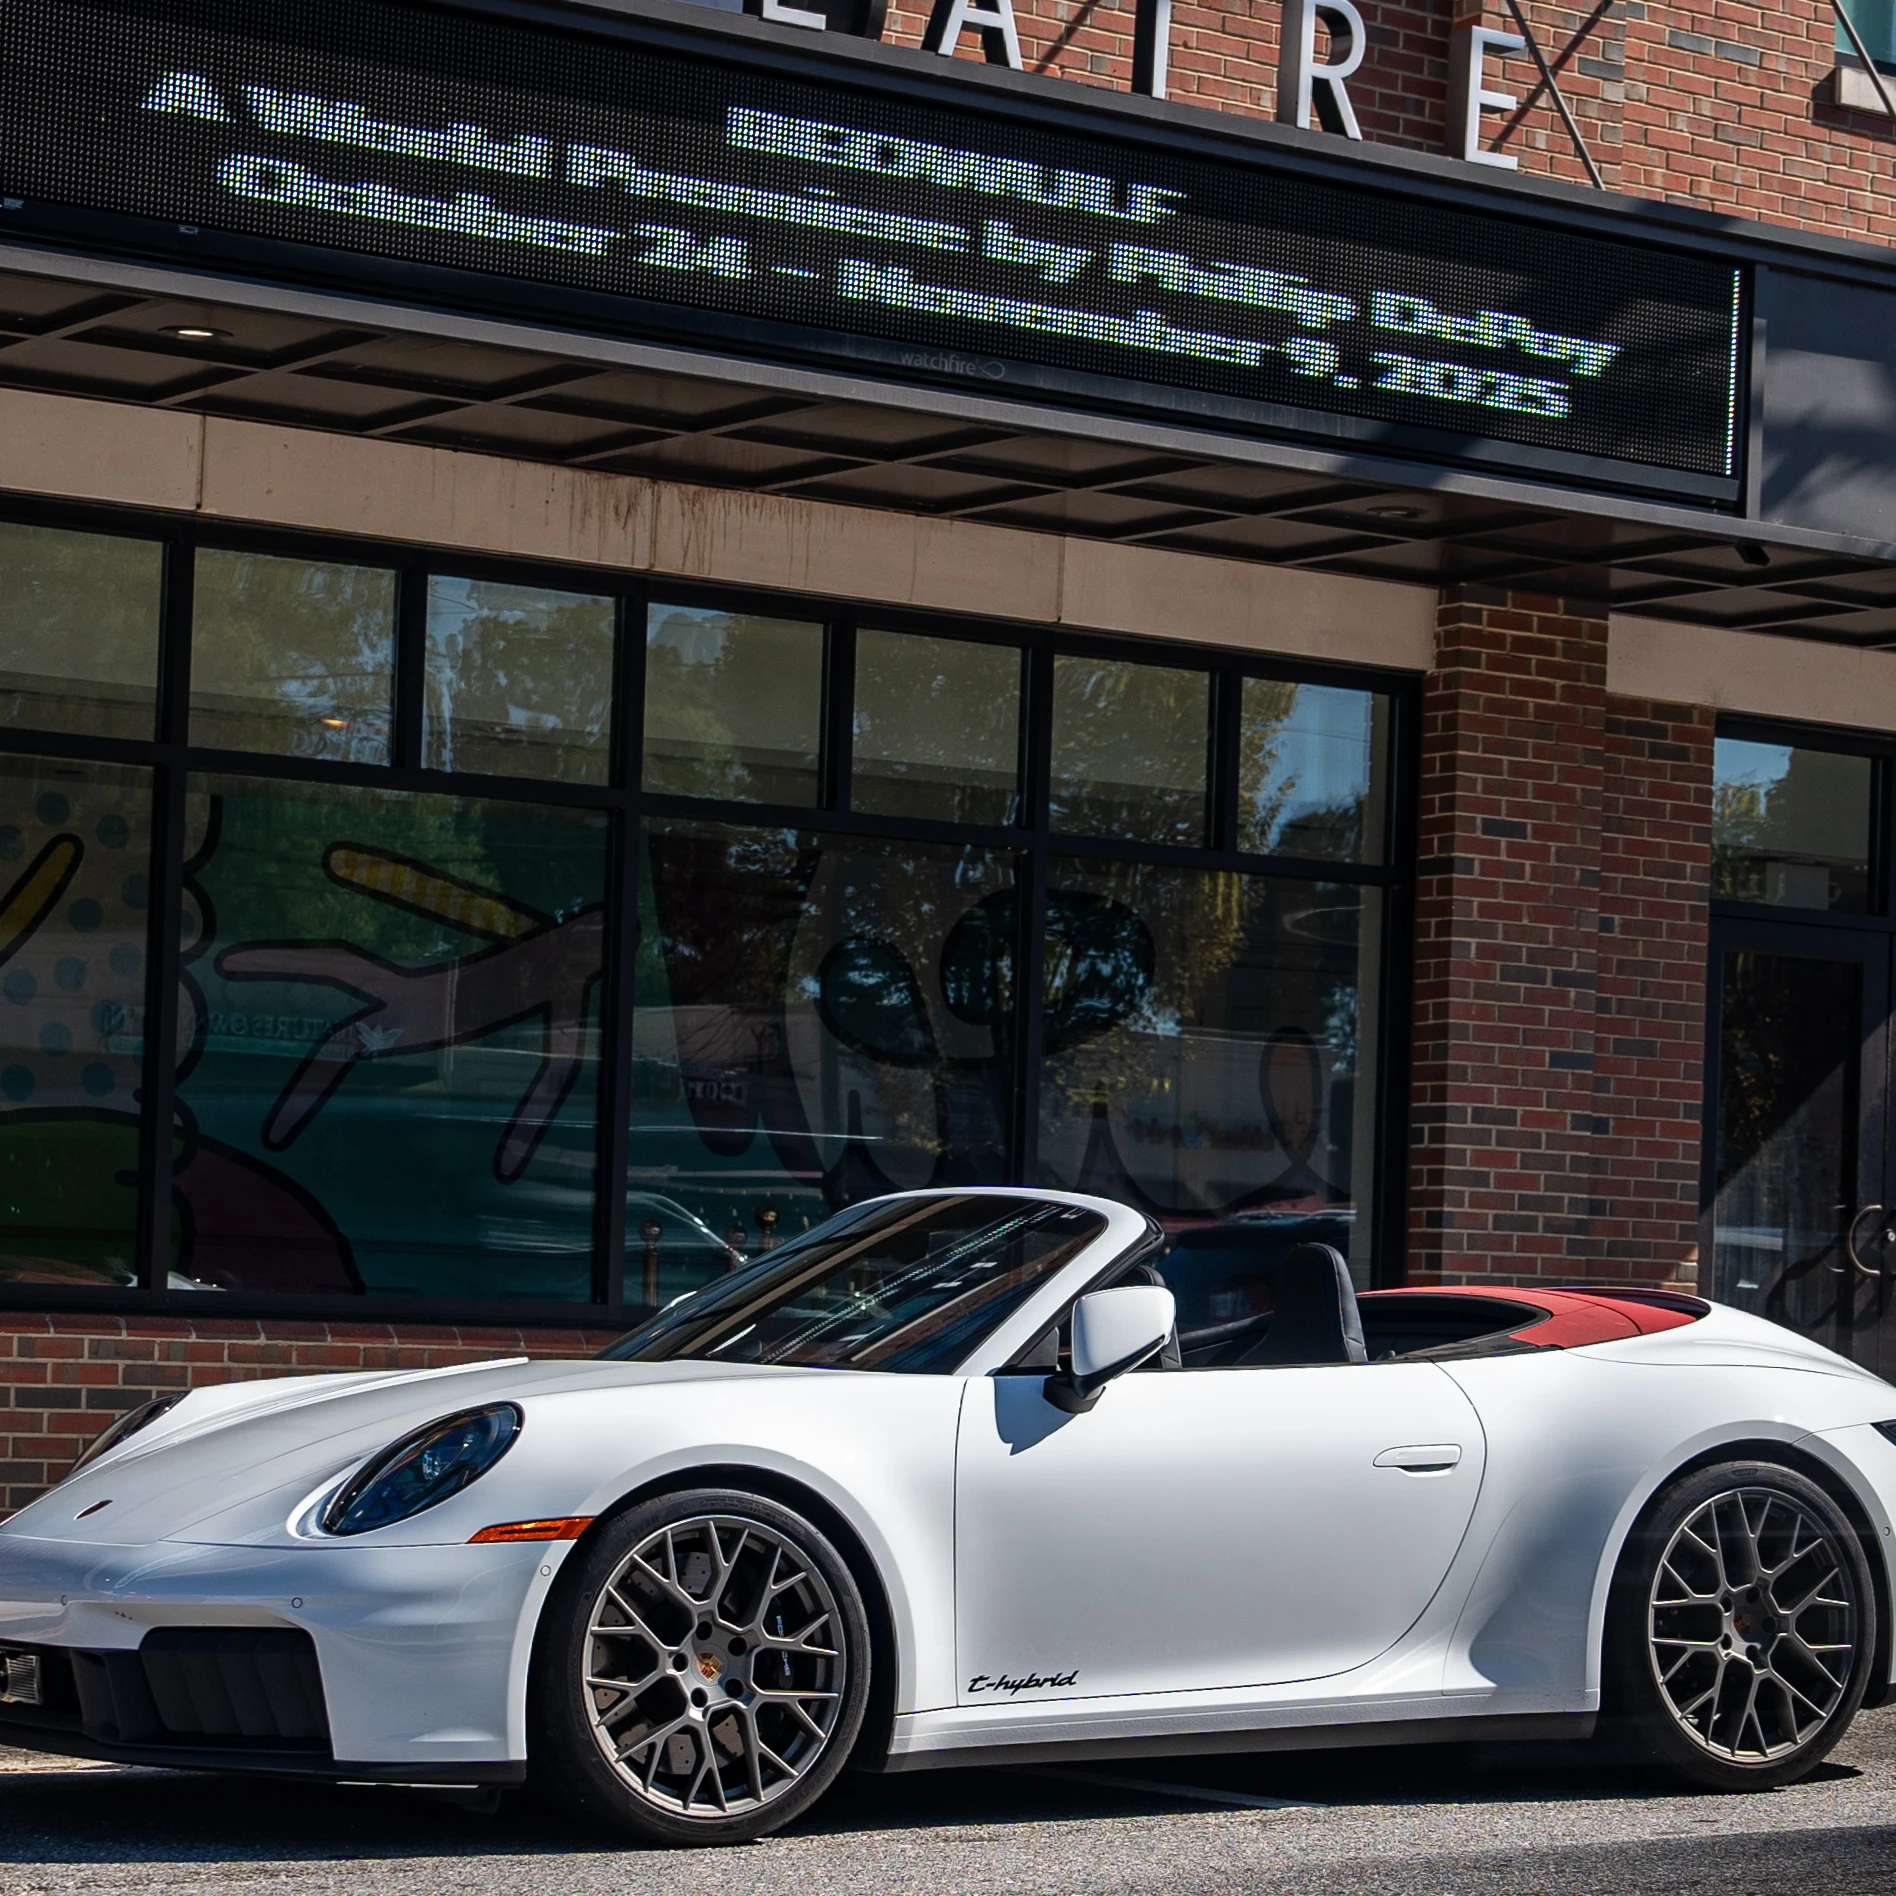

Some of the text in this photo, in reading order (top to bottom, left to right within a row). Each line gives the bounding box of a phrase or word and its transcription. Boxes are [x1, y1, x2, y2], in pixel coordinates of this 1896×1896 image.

[142, 72, 1621, 376] A World Premiere by Philip DePoy
[727, 106, 1187, 224] BEOWULF
[216, 154, 625, 256] October
[633, 223, 755, 279] 24
[838, 258, 1275, 367] November
[1281, 337, 1359, 389] 9,
[1371, 352, 1571, 418] 2025
[900, 352, 977, 375] watchfire
[968, 1670, 1080, 1696] t-hybrid
